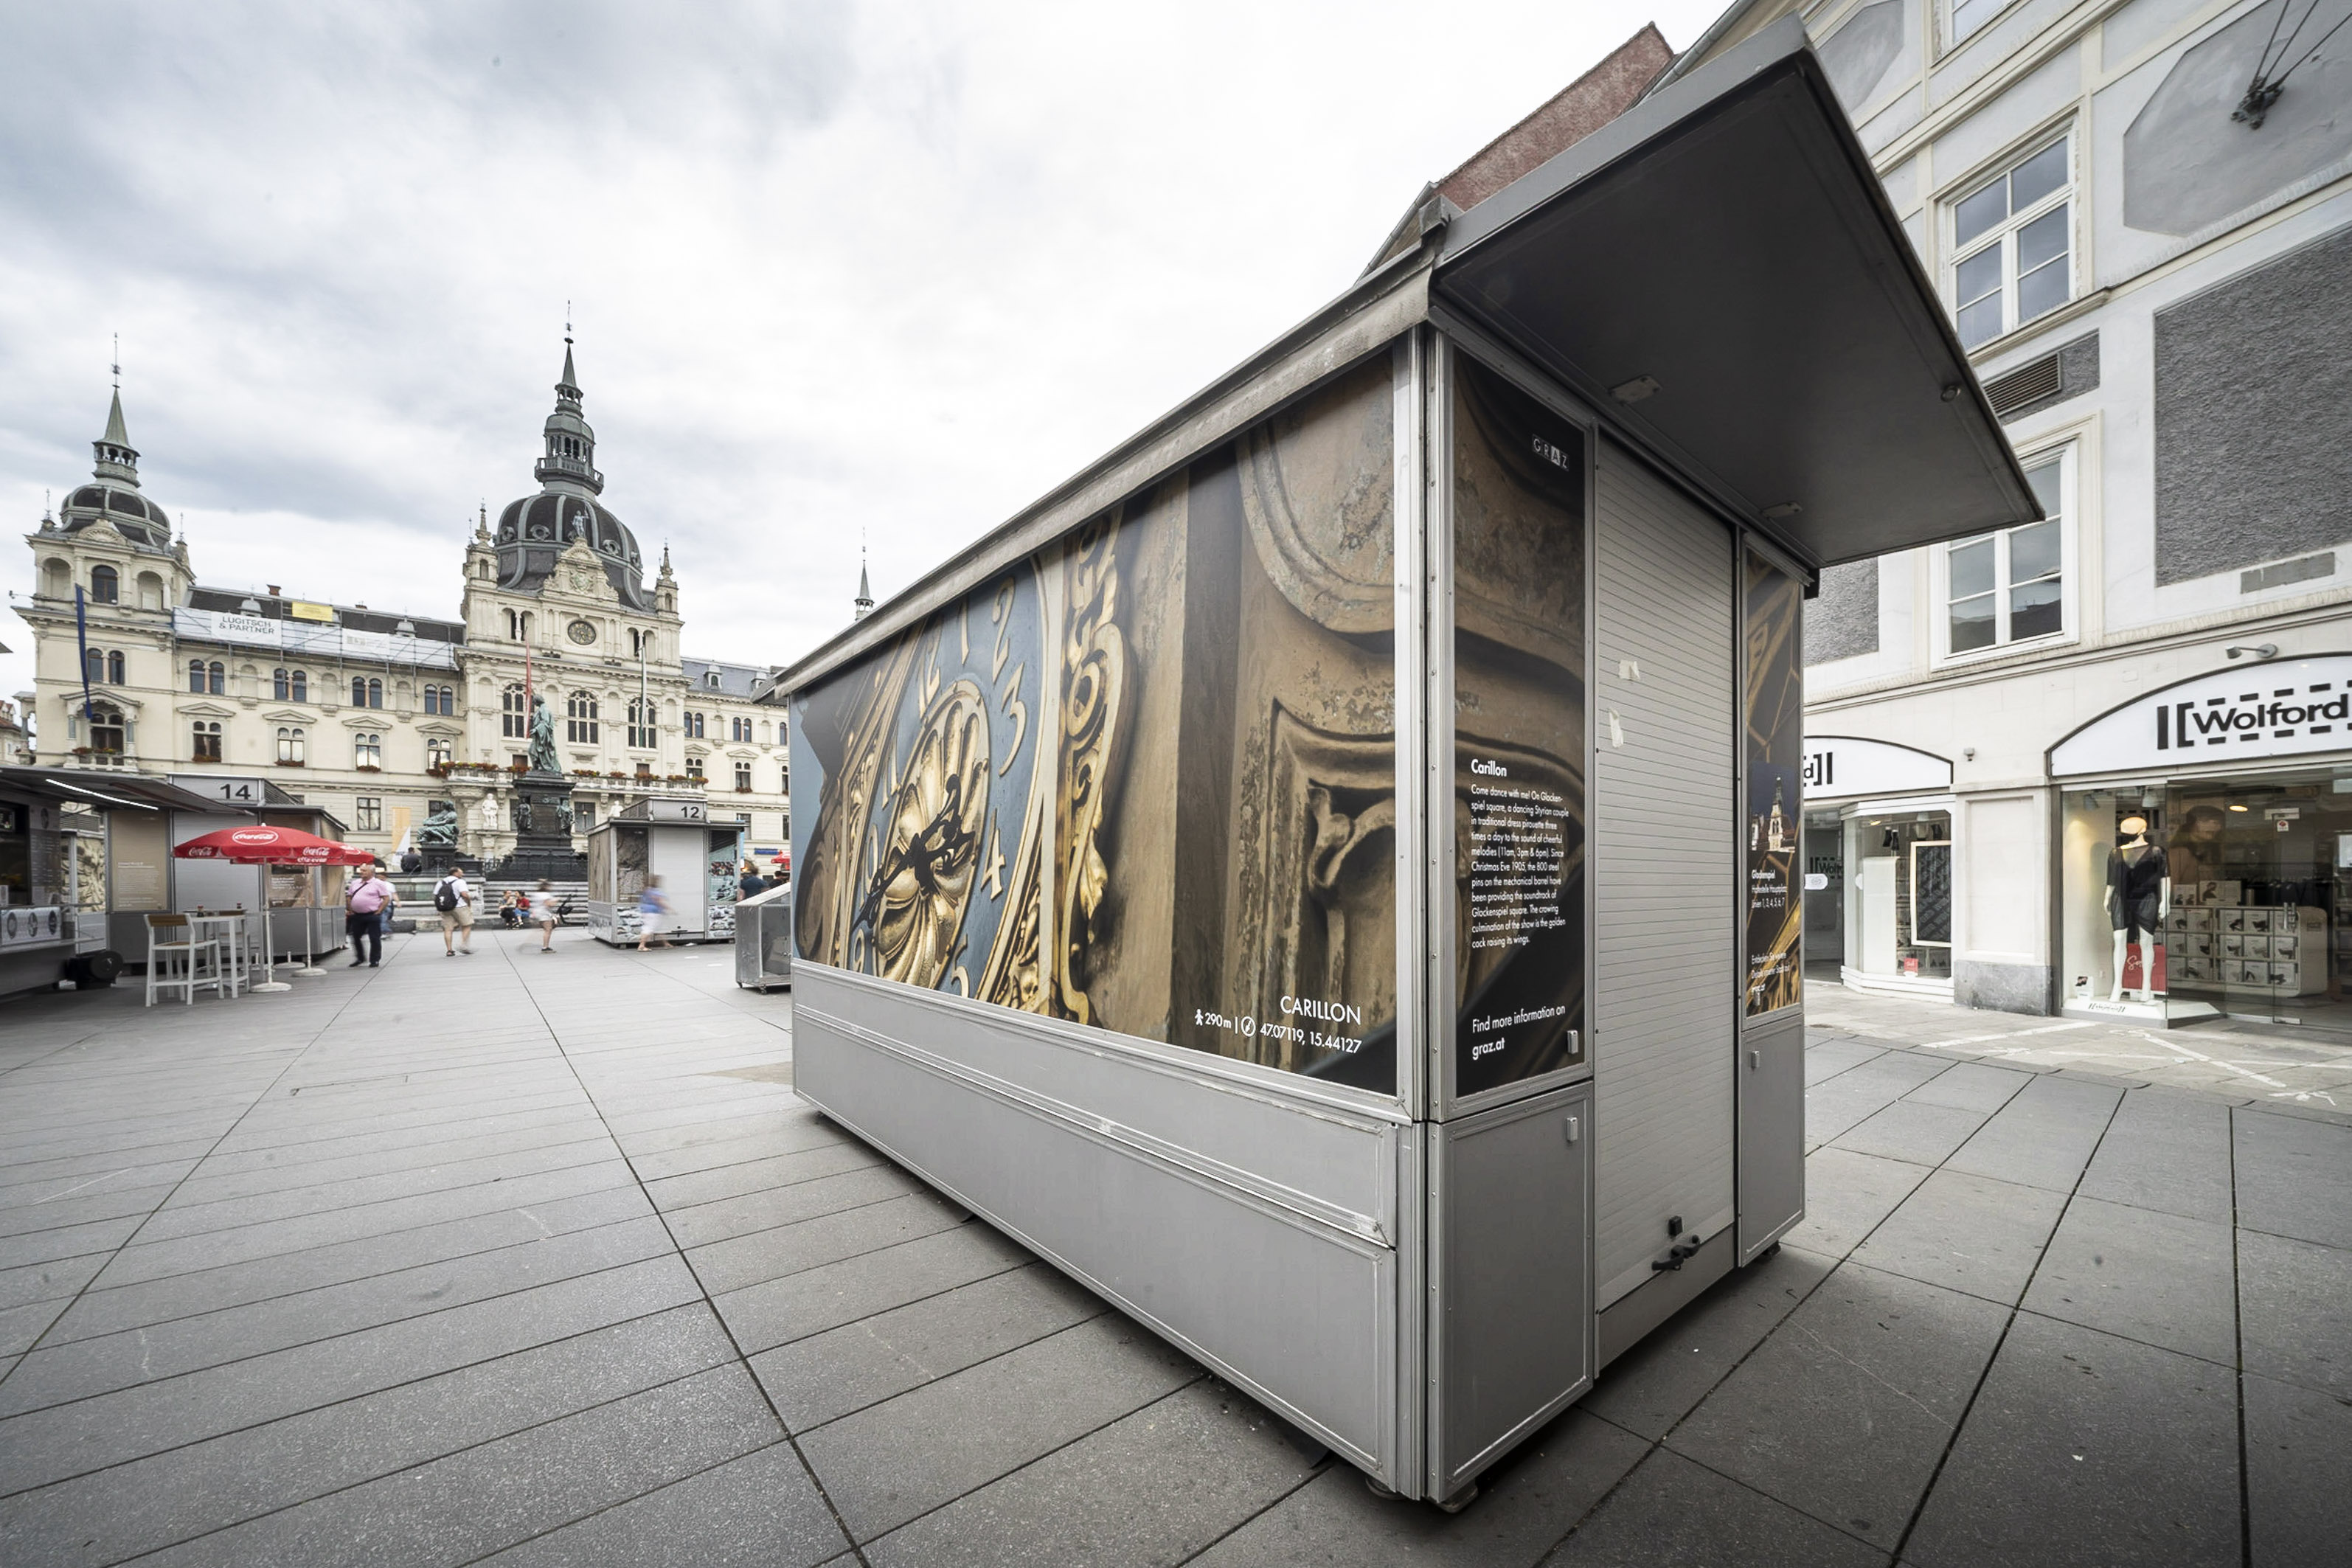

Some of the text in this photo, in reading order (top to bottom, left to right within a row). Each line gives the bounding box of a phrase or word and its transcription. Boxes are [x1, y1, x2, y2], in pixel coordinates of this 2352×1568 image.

[1534, 438, 1567, 469] GRAZ
[222, 617, 271, 628] LUGITSCH
[229, 624, 275, 634] PARTNER
[2192, 693, 2349, 735] Wolford
[1471, 759, 1507, 777] Carillon
[220, 784, 251, 800] 14
[1471, 784, 1488, 795] Come
[1490, 786, 1507, 797] dance
[1508, 788, 1519, 798] with
[1531, 791, 1539, 799] On
[681, 806, 700, 819] 12
[1471, 799, 1485, 811] spiel
[1486, 805, 1506, 814] square,
[1513, 803, 1534, 816] dancing
[1535, 805, 1552, 816] Styrian
[1553, 808, 1569, 818] couple
[1471, 816, 1557, 830] in traditional dress pirouette three
[1471, 832, 1486, 841] times
[1493, 831, 1504, 844] day
[1505, 833, 1510, 842] to
[1511, 832, 1519, 842] the
[1521, 833, 1536, 843] sound
[1537, 833, 1542, 843] of
[1543, 833, 1563, 844] cheerful
[1471, 845, 1497, 856] melodies
[1516, 847, 1529, 858] 3pm
[1530, 847, 1534, 857] &
[1551, 848, 1564, 858] Since
[1471, 861, 1499, 871] Christmas
[1500, 861, 1510, 871] Eve
[1527, 861, 1536, 871] the
[1536, 861, 1547, 871] 800
[1548, 861, 1560, 871] steel
[1471, 877, 1484, 889] pins
[1493, 875, 1502, 887] the
[1503, 875, 1533, 886] mechanical
[1534, 875, 1548, 885] barrel
[1549, 875, 1562, 885] have
[1471, 888, 1557, 904] been providing the soundtrack of
[1471, 903, 1558, 918] Glockenspiel square. The crowing
[1471, 916, 1566, 933] culmination of the show is the golden
[1471, 937, 1485, 948] cock
[1487, 937, 1505, 948] raising
[1513, 934, 1530, 946] wings.
[1280, 996, 1361, 1025] CARILLON
[1472, 1005, 1566, 1033] Find more information on
[1205, 1013, 1232, 1029] 290m
[1260, 1024, 1305, 1046] 47.07119,
[1310, 1031, 1362, 1054] 15.44127
[1472, 1037, 1505, 1061] graz.at
